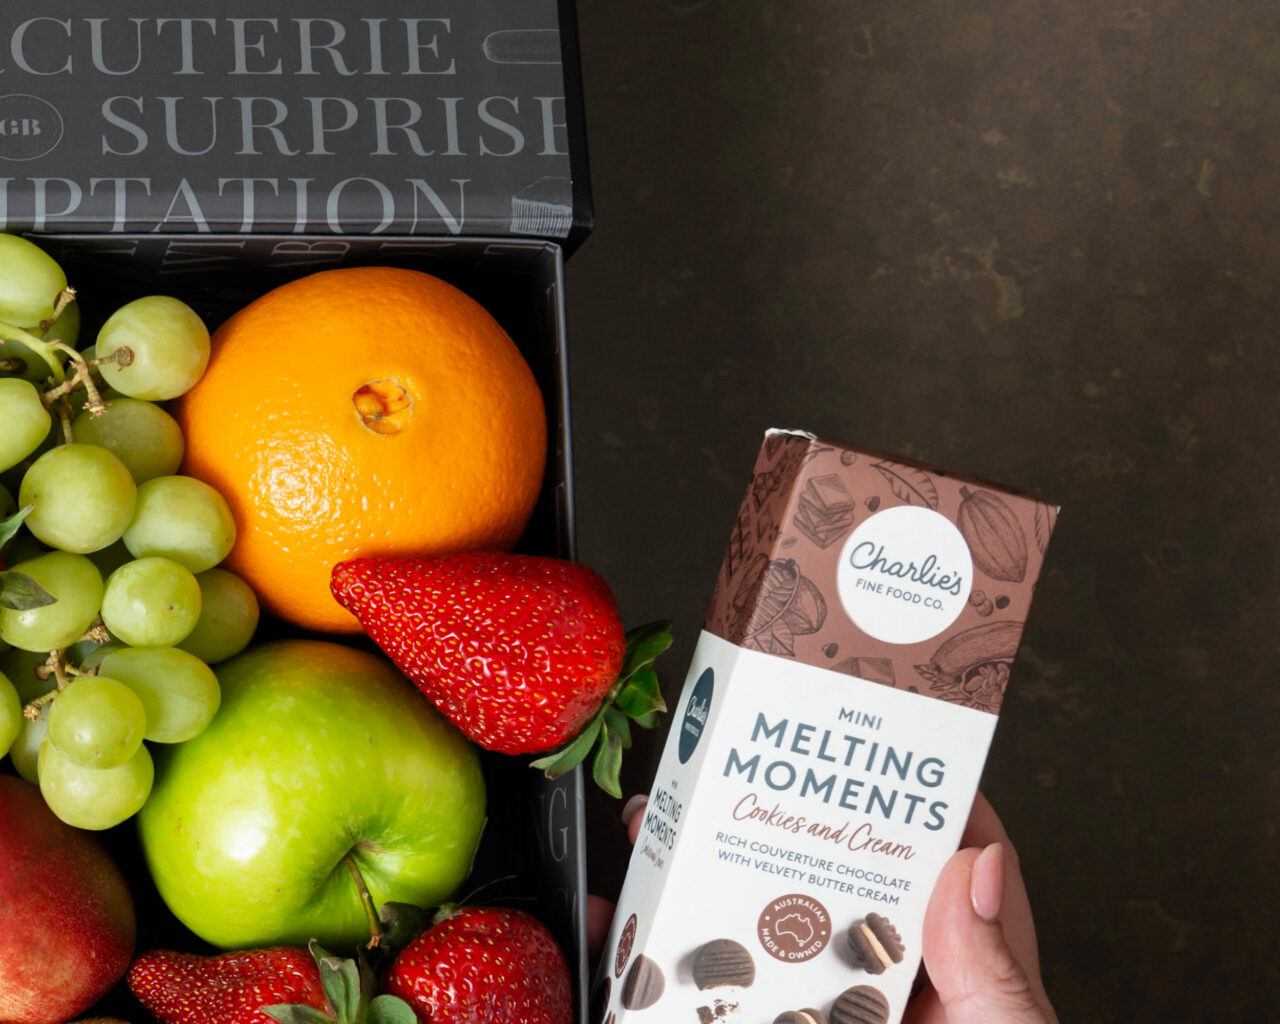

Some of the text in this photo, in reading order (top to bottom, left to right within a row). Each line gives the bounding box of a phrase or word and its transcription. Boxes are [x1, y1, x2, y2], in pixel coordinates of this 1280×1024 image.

[849, 541, 962, 596] Charlie's
[855, 578, 944, 611] FINE FOOD CO.
[838, 707, 883, 730] MINI
[750, 711, 946, 788] MELTING
[653, 786, 682, 824] MELTING
[722, 747, 950, 831] MOMENTS
[644, 810, 677, 851] MOMENTS
[732, 793, 916, 861] Cookies and Cream
[716, 831, 911, 891] RICH COUVERTURE CHOCOLATE
[718, 849, 900, 906] WITH VELVETY BUTTER CREAM
[774, 898, 826, 923] AUSTRALIAN
[761, 928, 779, 952] MADE
[788, 940, 822, 959] OWNED
